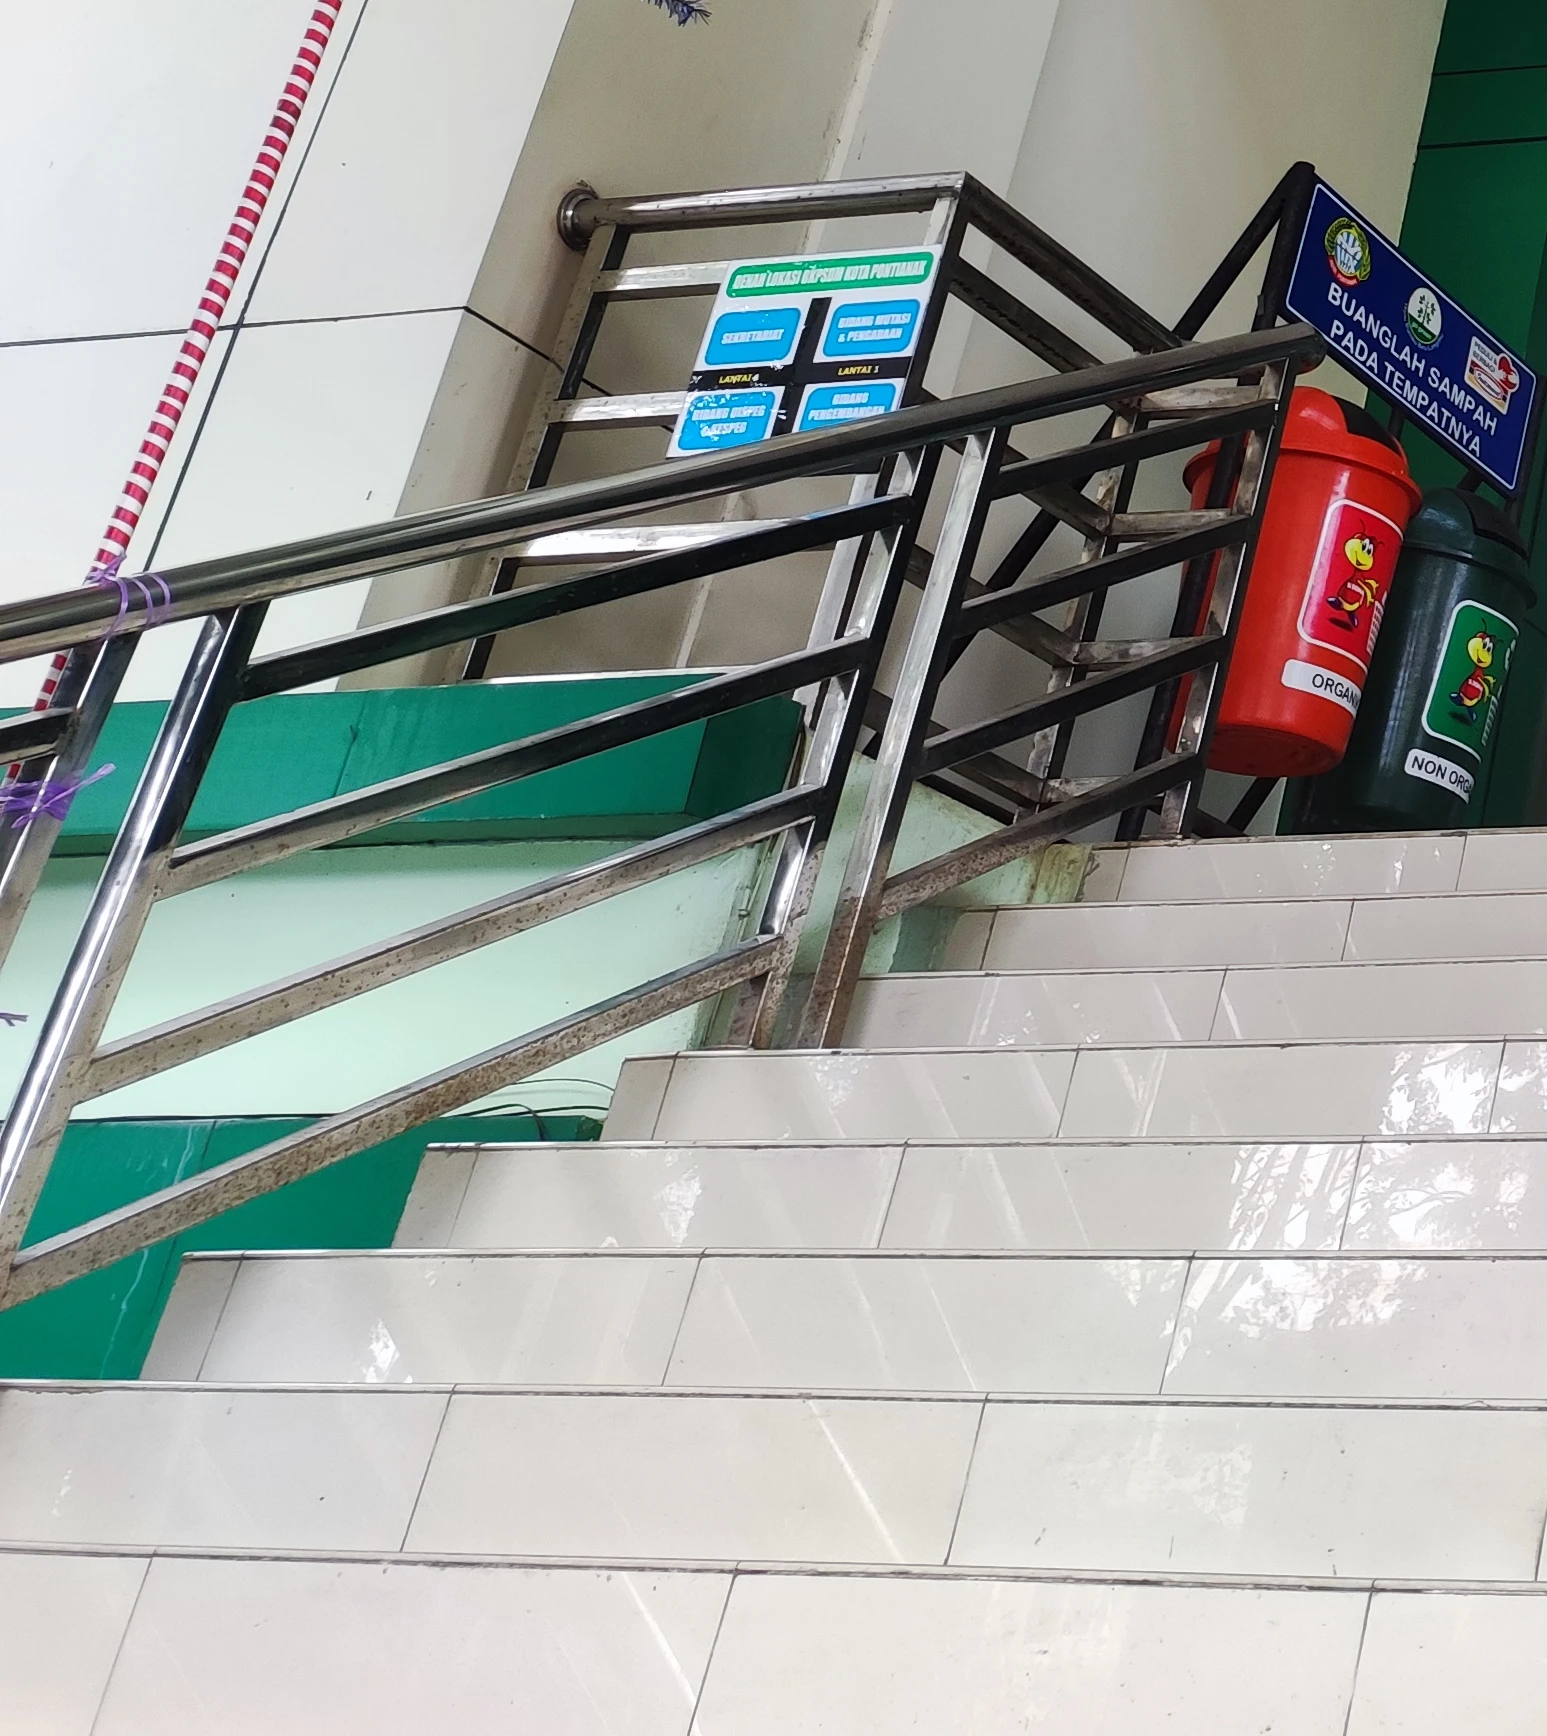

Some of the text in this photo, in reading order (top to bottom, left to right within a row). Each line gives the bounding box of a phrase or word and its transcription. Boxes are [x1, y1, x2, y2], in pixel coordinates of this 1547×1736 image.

[869, 260, 928, 280] PONTIANAK
[1327, 282, 1426, 378] BUANGLAH
[1428, 367, 1498, 436] SAMPAH
[718, 373, 753, 385] LANTAI
[837, 365, 873, 376] LANTAI
[1330, 319, 1378, 375] PADA
[1383, 361, 1482, 458] TEMPATNYA
[1411, 755, 1448, 780] NON
